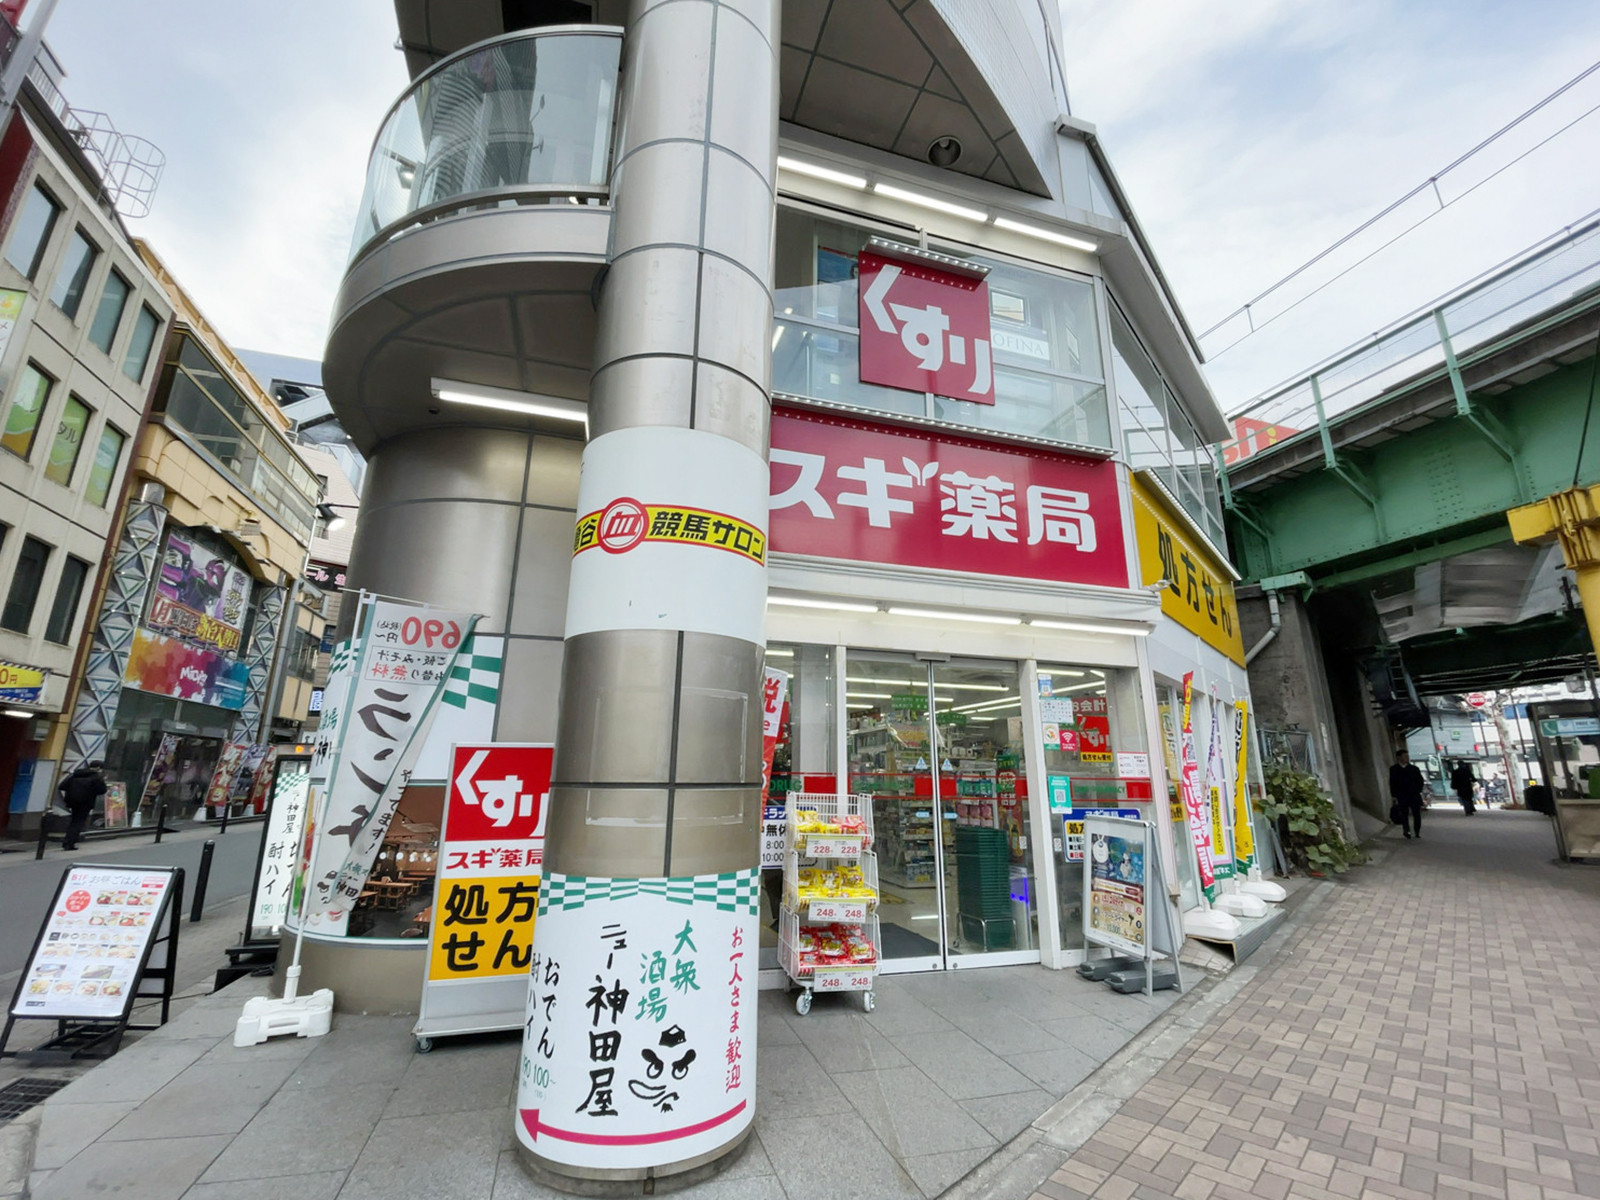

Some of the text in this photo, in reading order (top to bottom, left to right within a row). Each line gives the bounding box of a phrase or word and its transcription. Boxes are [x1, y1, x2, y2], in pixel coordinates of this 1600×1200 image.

[863, 264, 994, 395] くすり
[650, 511, 764, 560] 競馬サロン
[768, 448, 1097, 553] スギ薬局
[1157, 522, 1233, 639] 処方せん
[455, 750, 549, 837] くすり
[446, 848, 543, 869] スギ薬局
[444, 882, 539, 927] 処方
[441, 929, 533, 971] せん
[635, 950, 669, 1023] 酒場
[672, 919, 701, 994] 大衆
[537, 956, 560, 1059] おでん
[575, 923, 630, 1117] ニュー神田屋
[725, 926, 744, 1093] お一人さま歓迎
